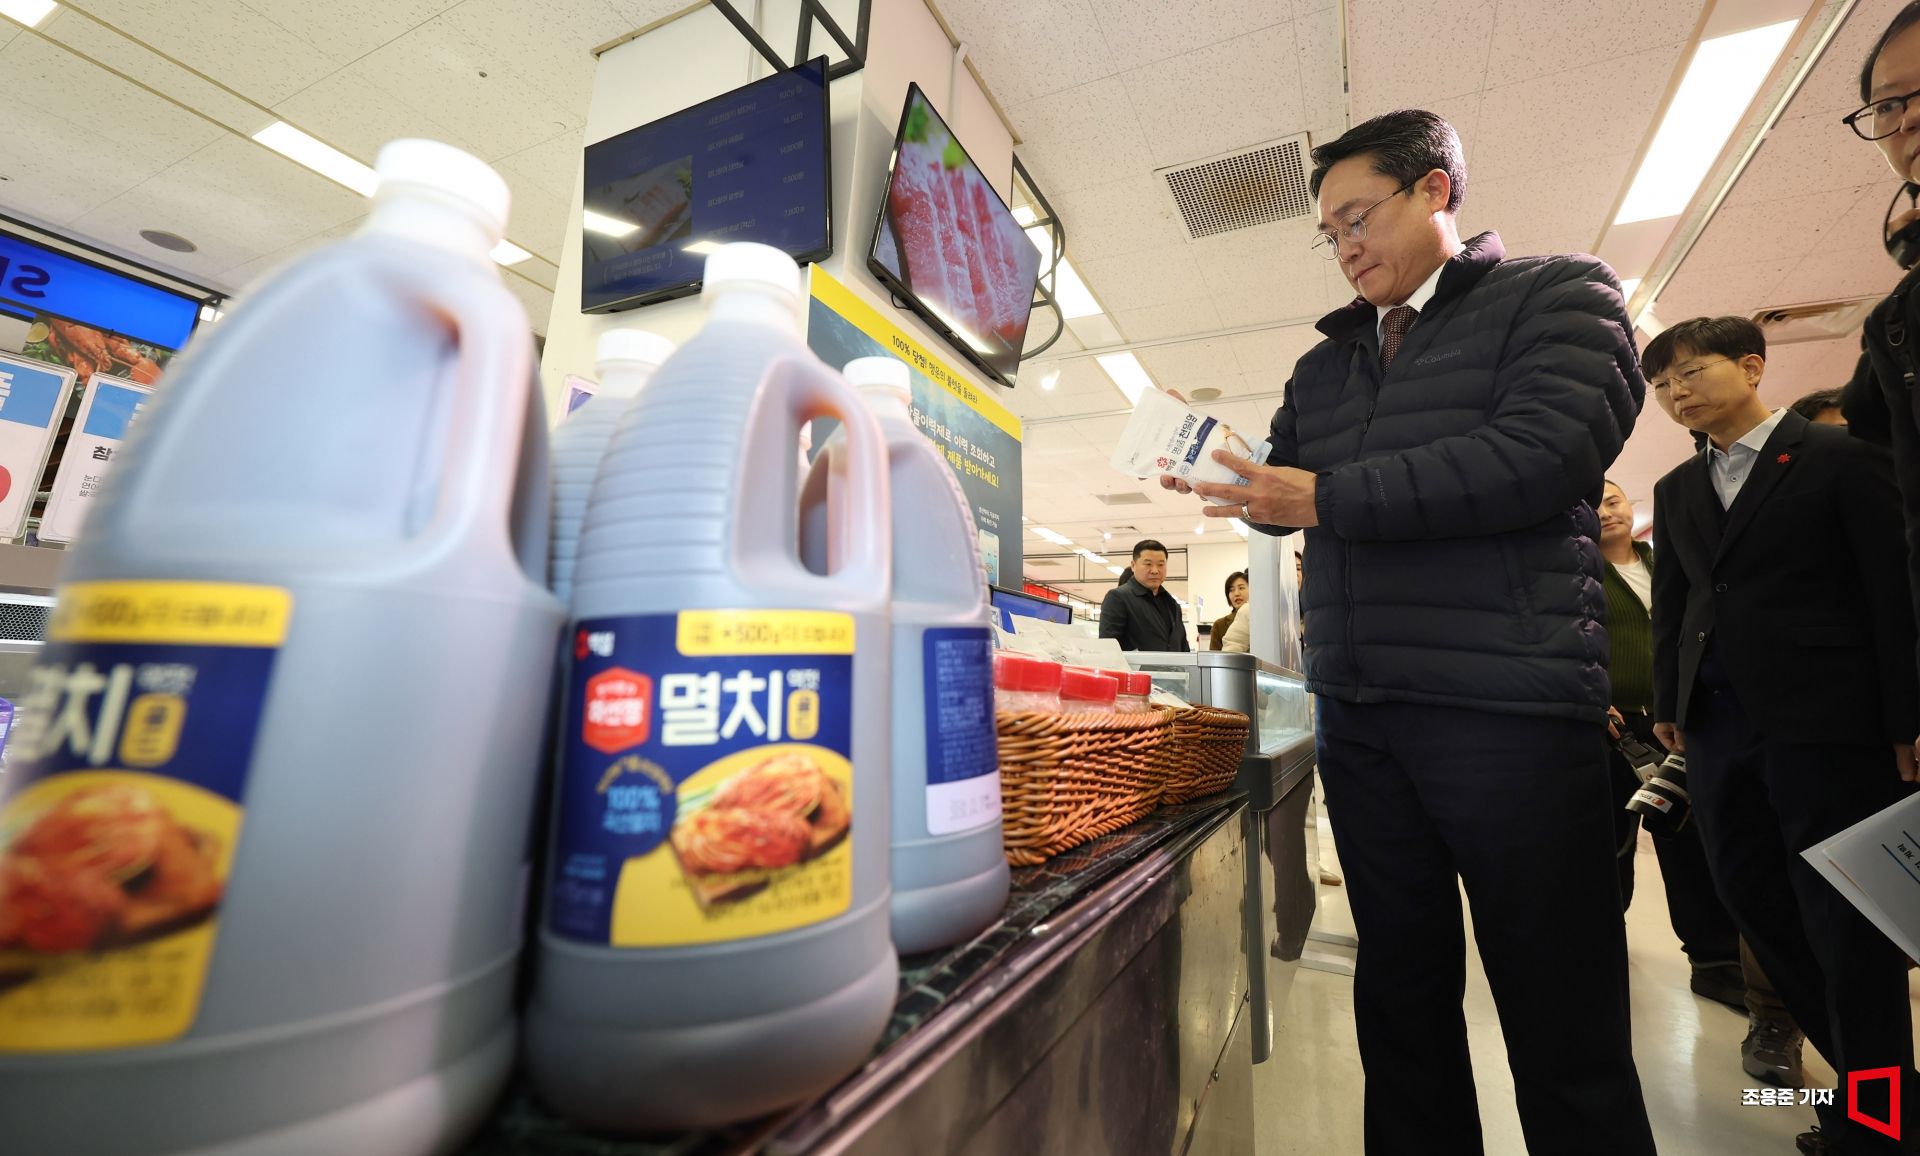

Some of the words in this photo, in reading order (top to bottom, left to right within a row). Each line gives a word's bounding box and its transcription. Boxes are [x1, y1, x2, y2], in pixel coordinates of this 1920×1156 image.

[892, 335, 910, 356] 100%
[912, 350, 927, 369] 당첨!
[1178, 413, 1198, 439] 천일염
[947, 449, 962, 470] 제품
[964, 458, 999, 489] 받아가세요!
[954, 434, 968, 455] 이력
[970, 443, 996, 469] 조회하고
[659, 669, 784, 746] 멸치
